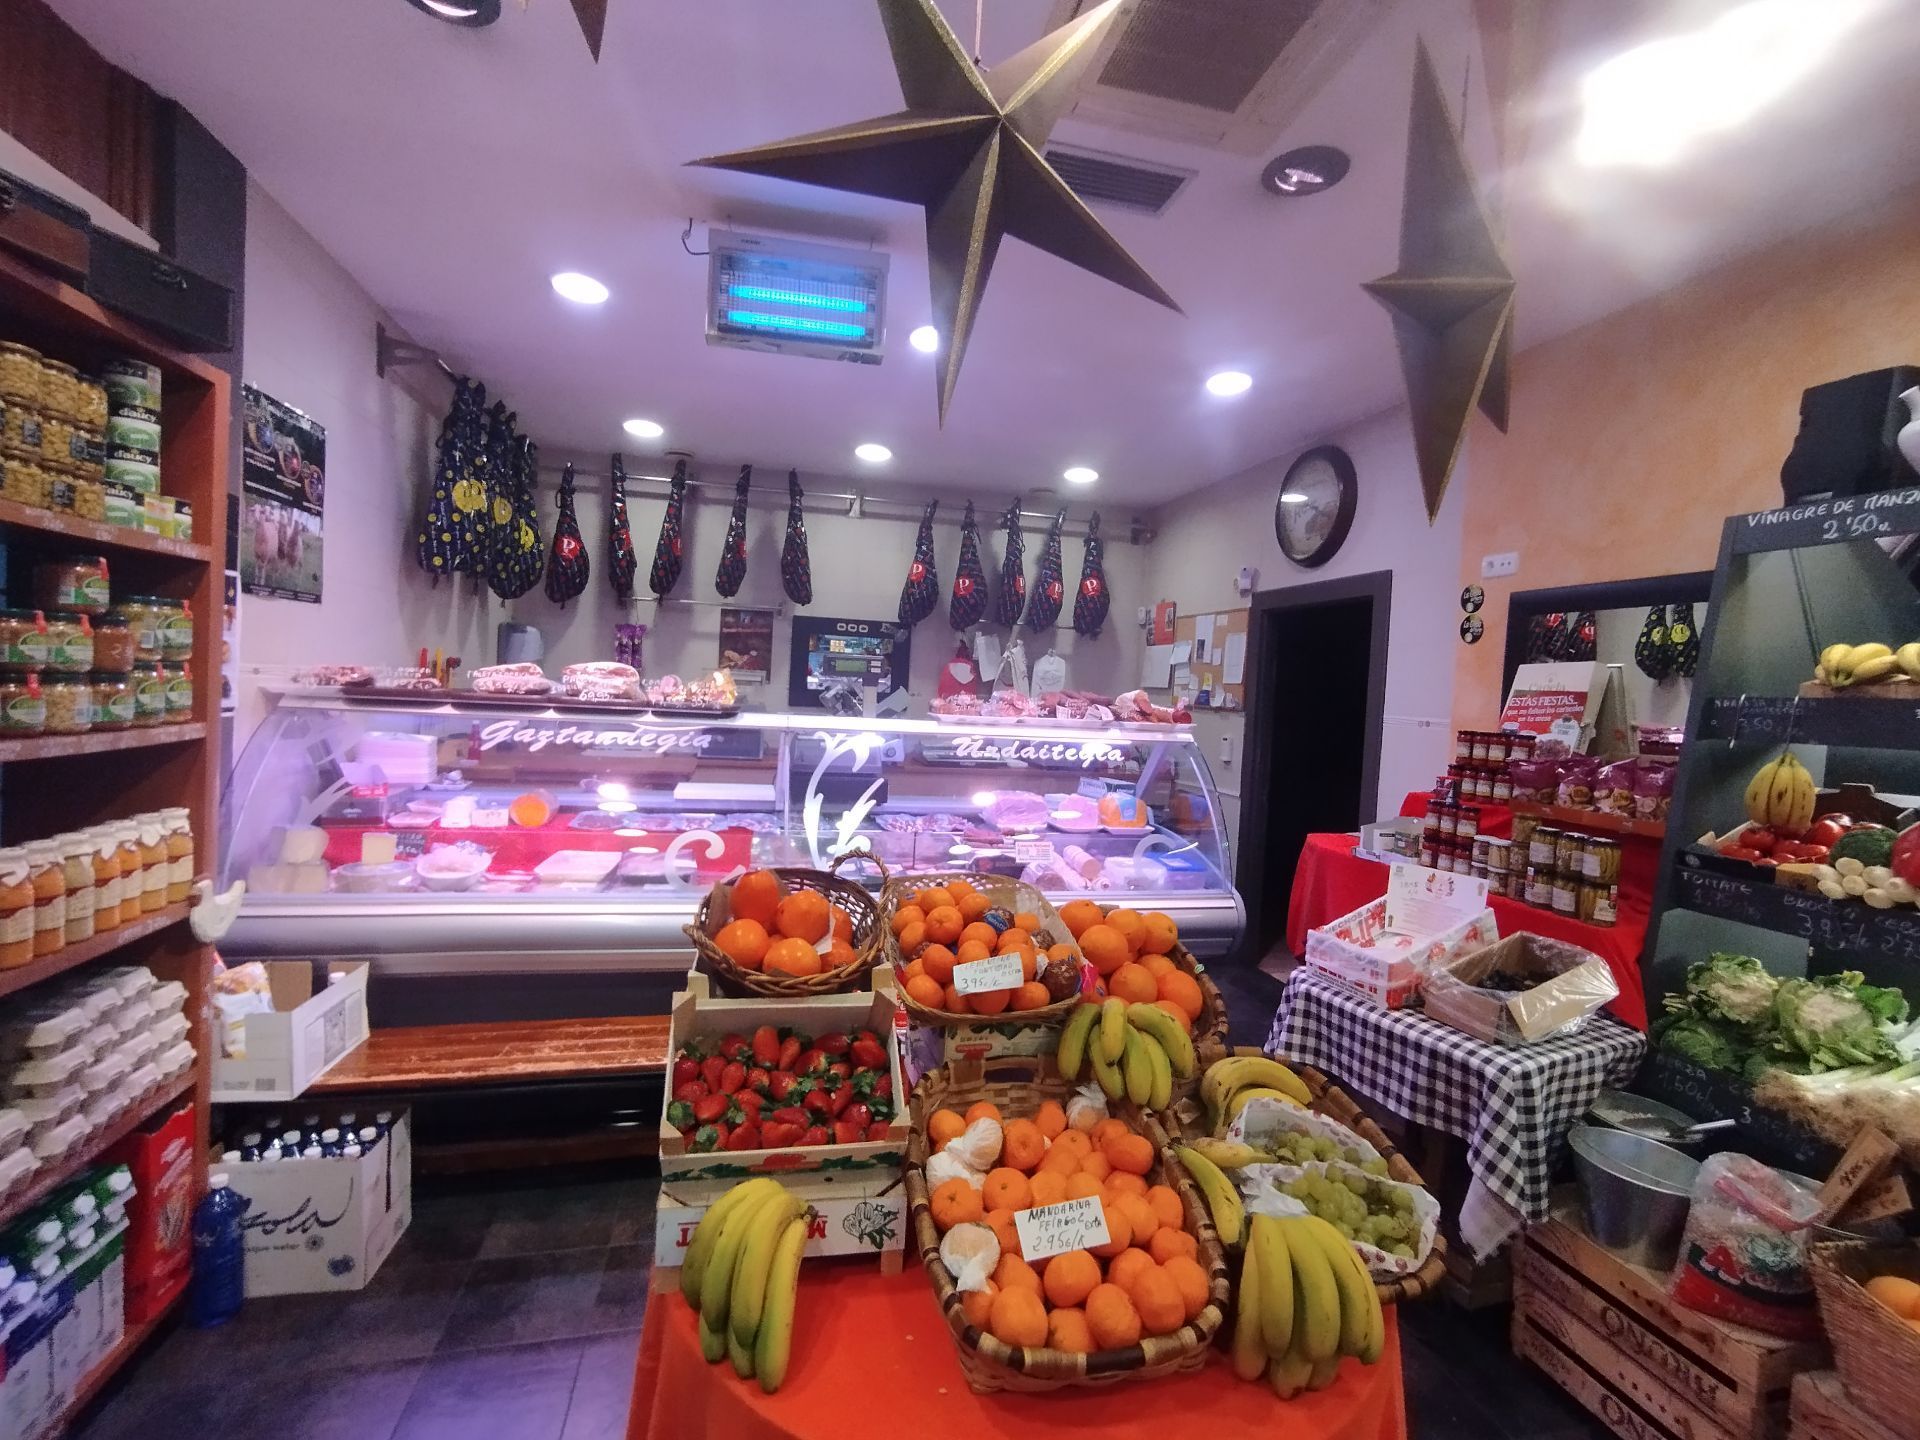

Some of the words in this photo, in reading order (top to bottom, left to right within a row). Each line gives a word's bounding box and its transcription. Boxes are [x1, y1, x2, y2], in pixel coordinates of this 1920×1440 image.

[1748, 503, 1828, 528] VINAGRE
[1833, 499, 1855, 515] DE
[480, 720, 712, 753] Gaztandegia
[1680, 871, 1753, 895] TOMATE
[1028, 1199, 1091, 1222] MANDARINA
